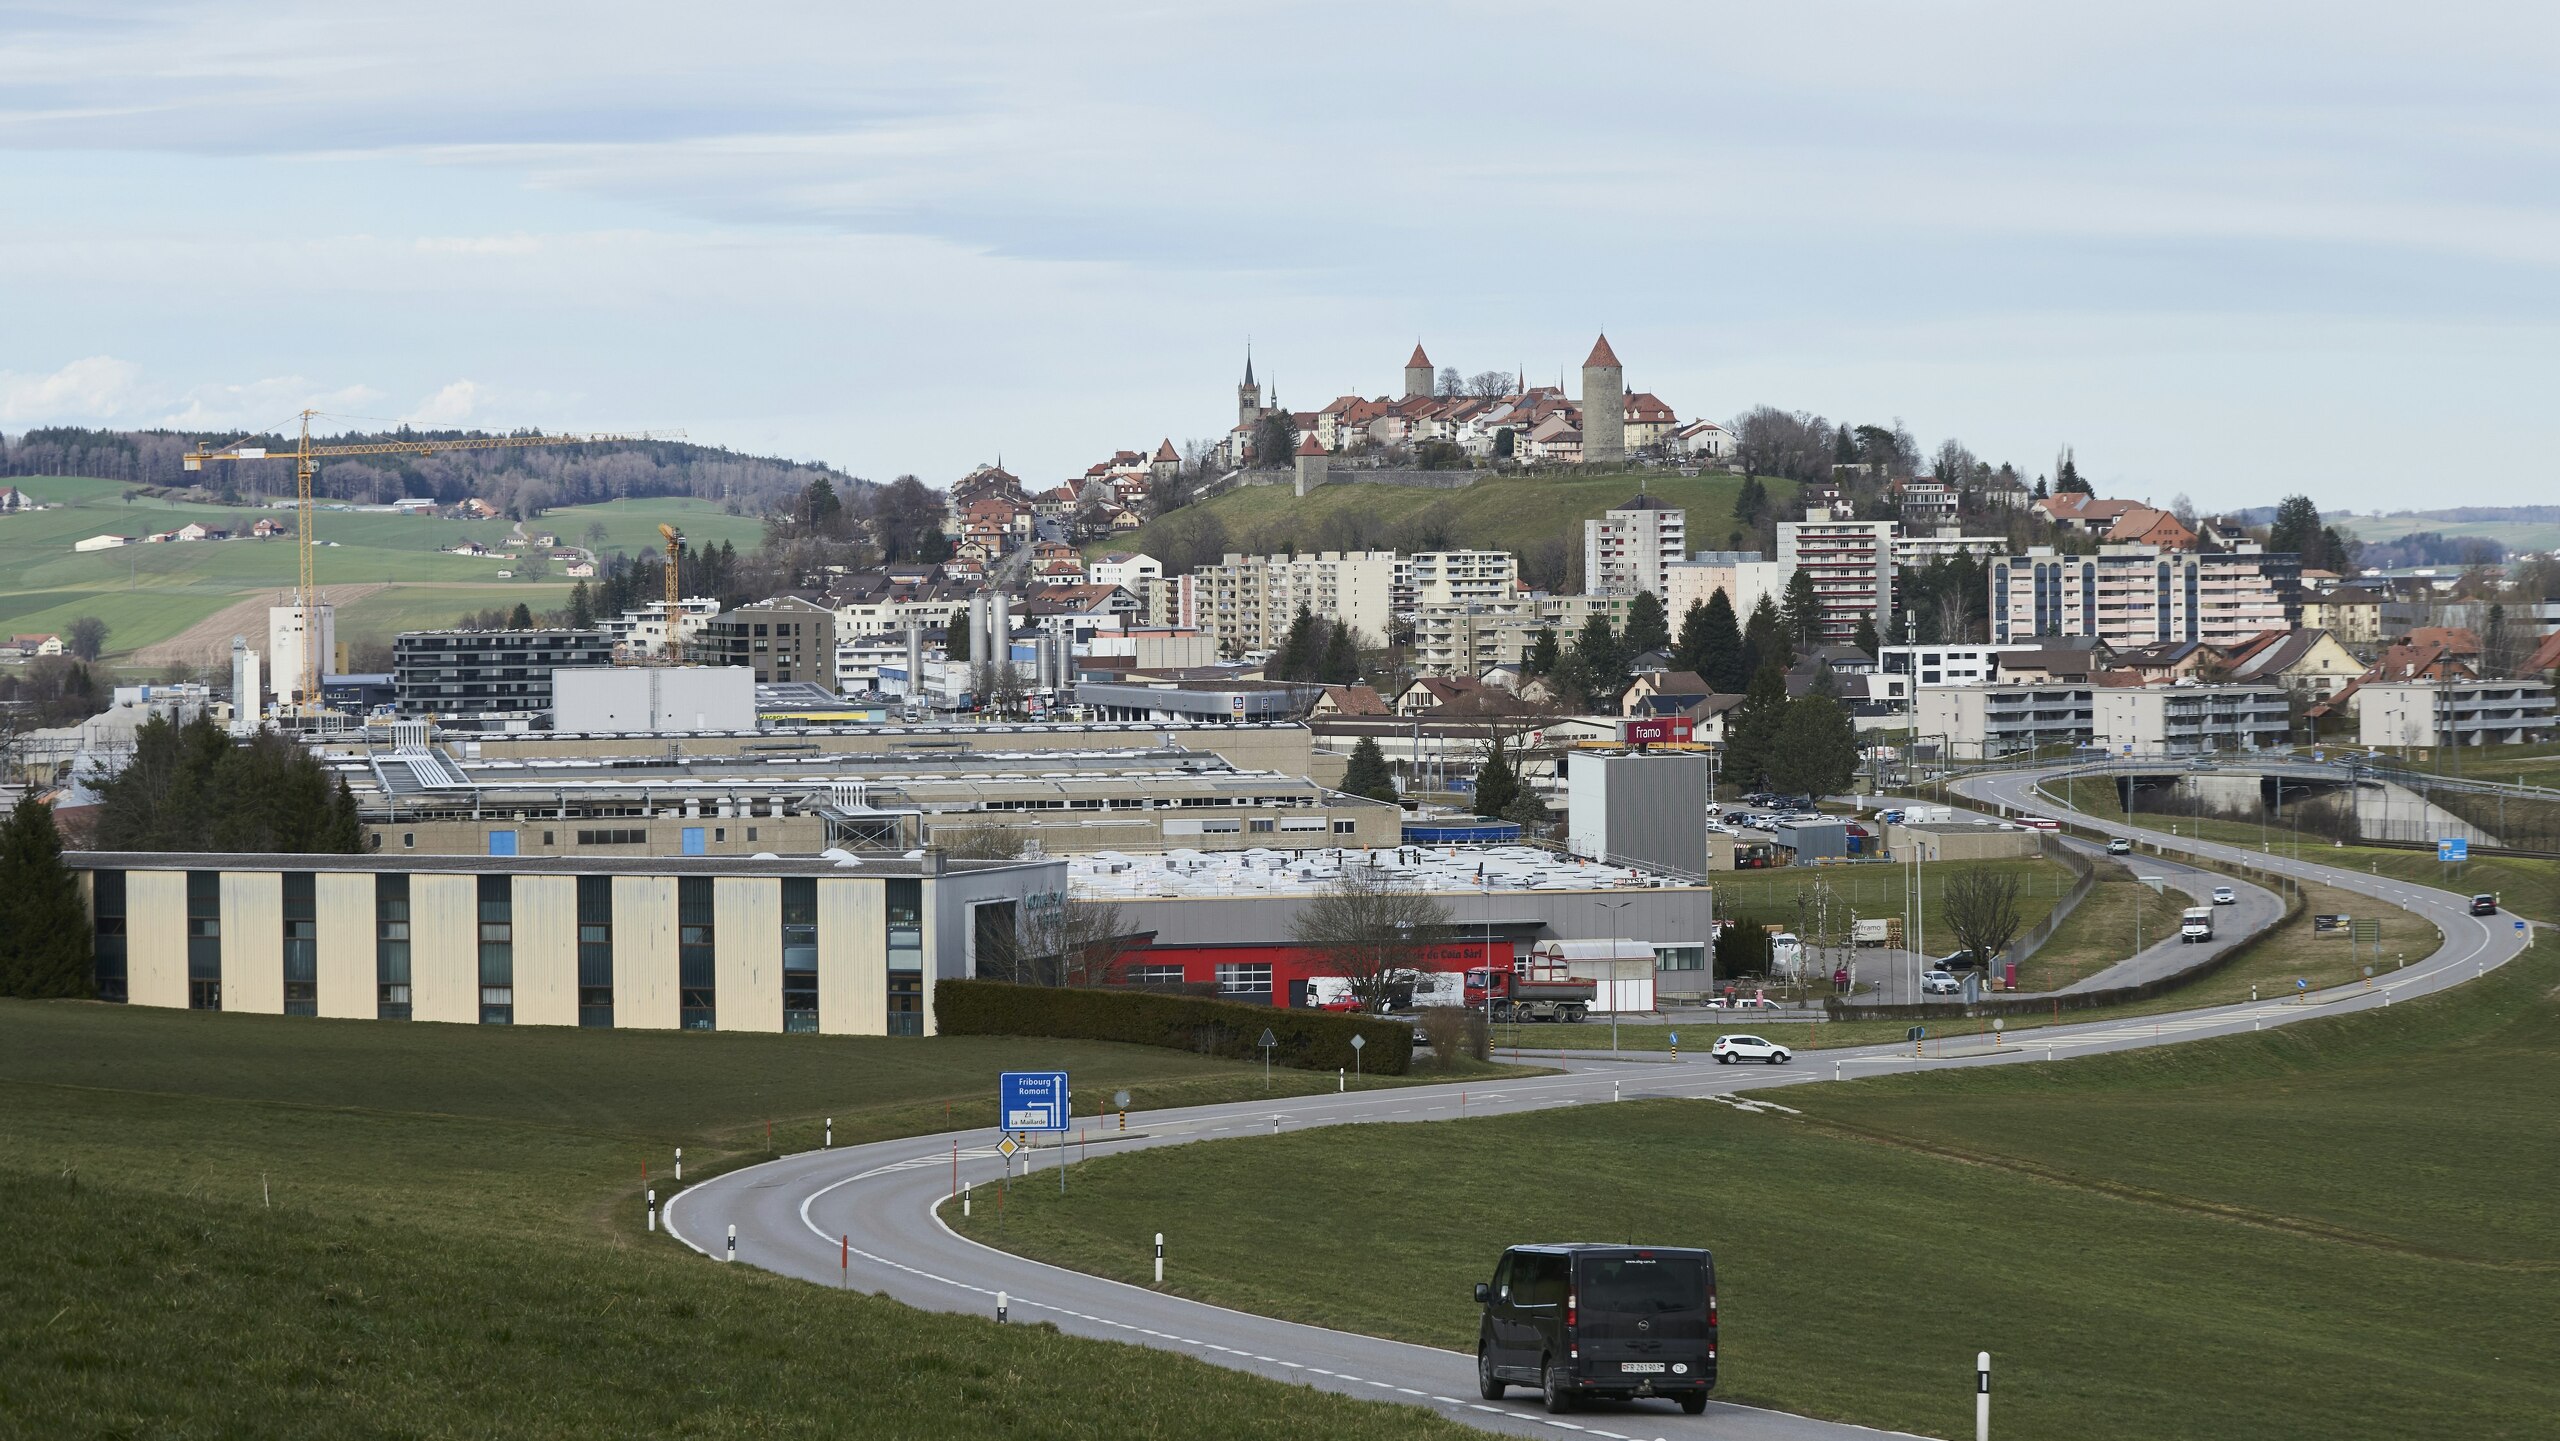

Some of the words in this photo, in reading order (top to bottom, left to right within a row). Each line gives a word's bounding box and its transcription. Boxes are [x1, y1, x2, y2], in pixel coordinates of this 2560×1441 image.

[1636, 726, 1661, 739] framo
[1441, 949, 1462, 959] Coin
[1019, 1078, 1051, 1087] Fribourg
[1675, 1364, 1684, 1373] CH
